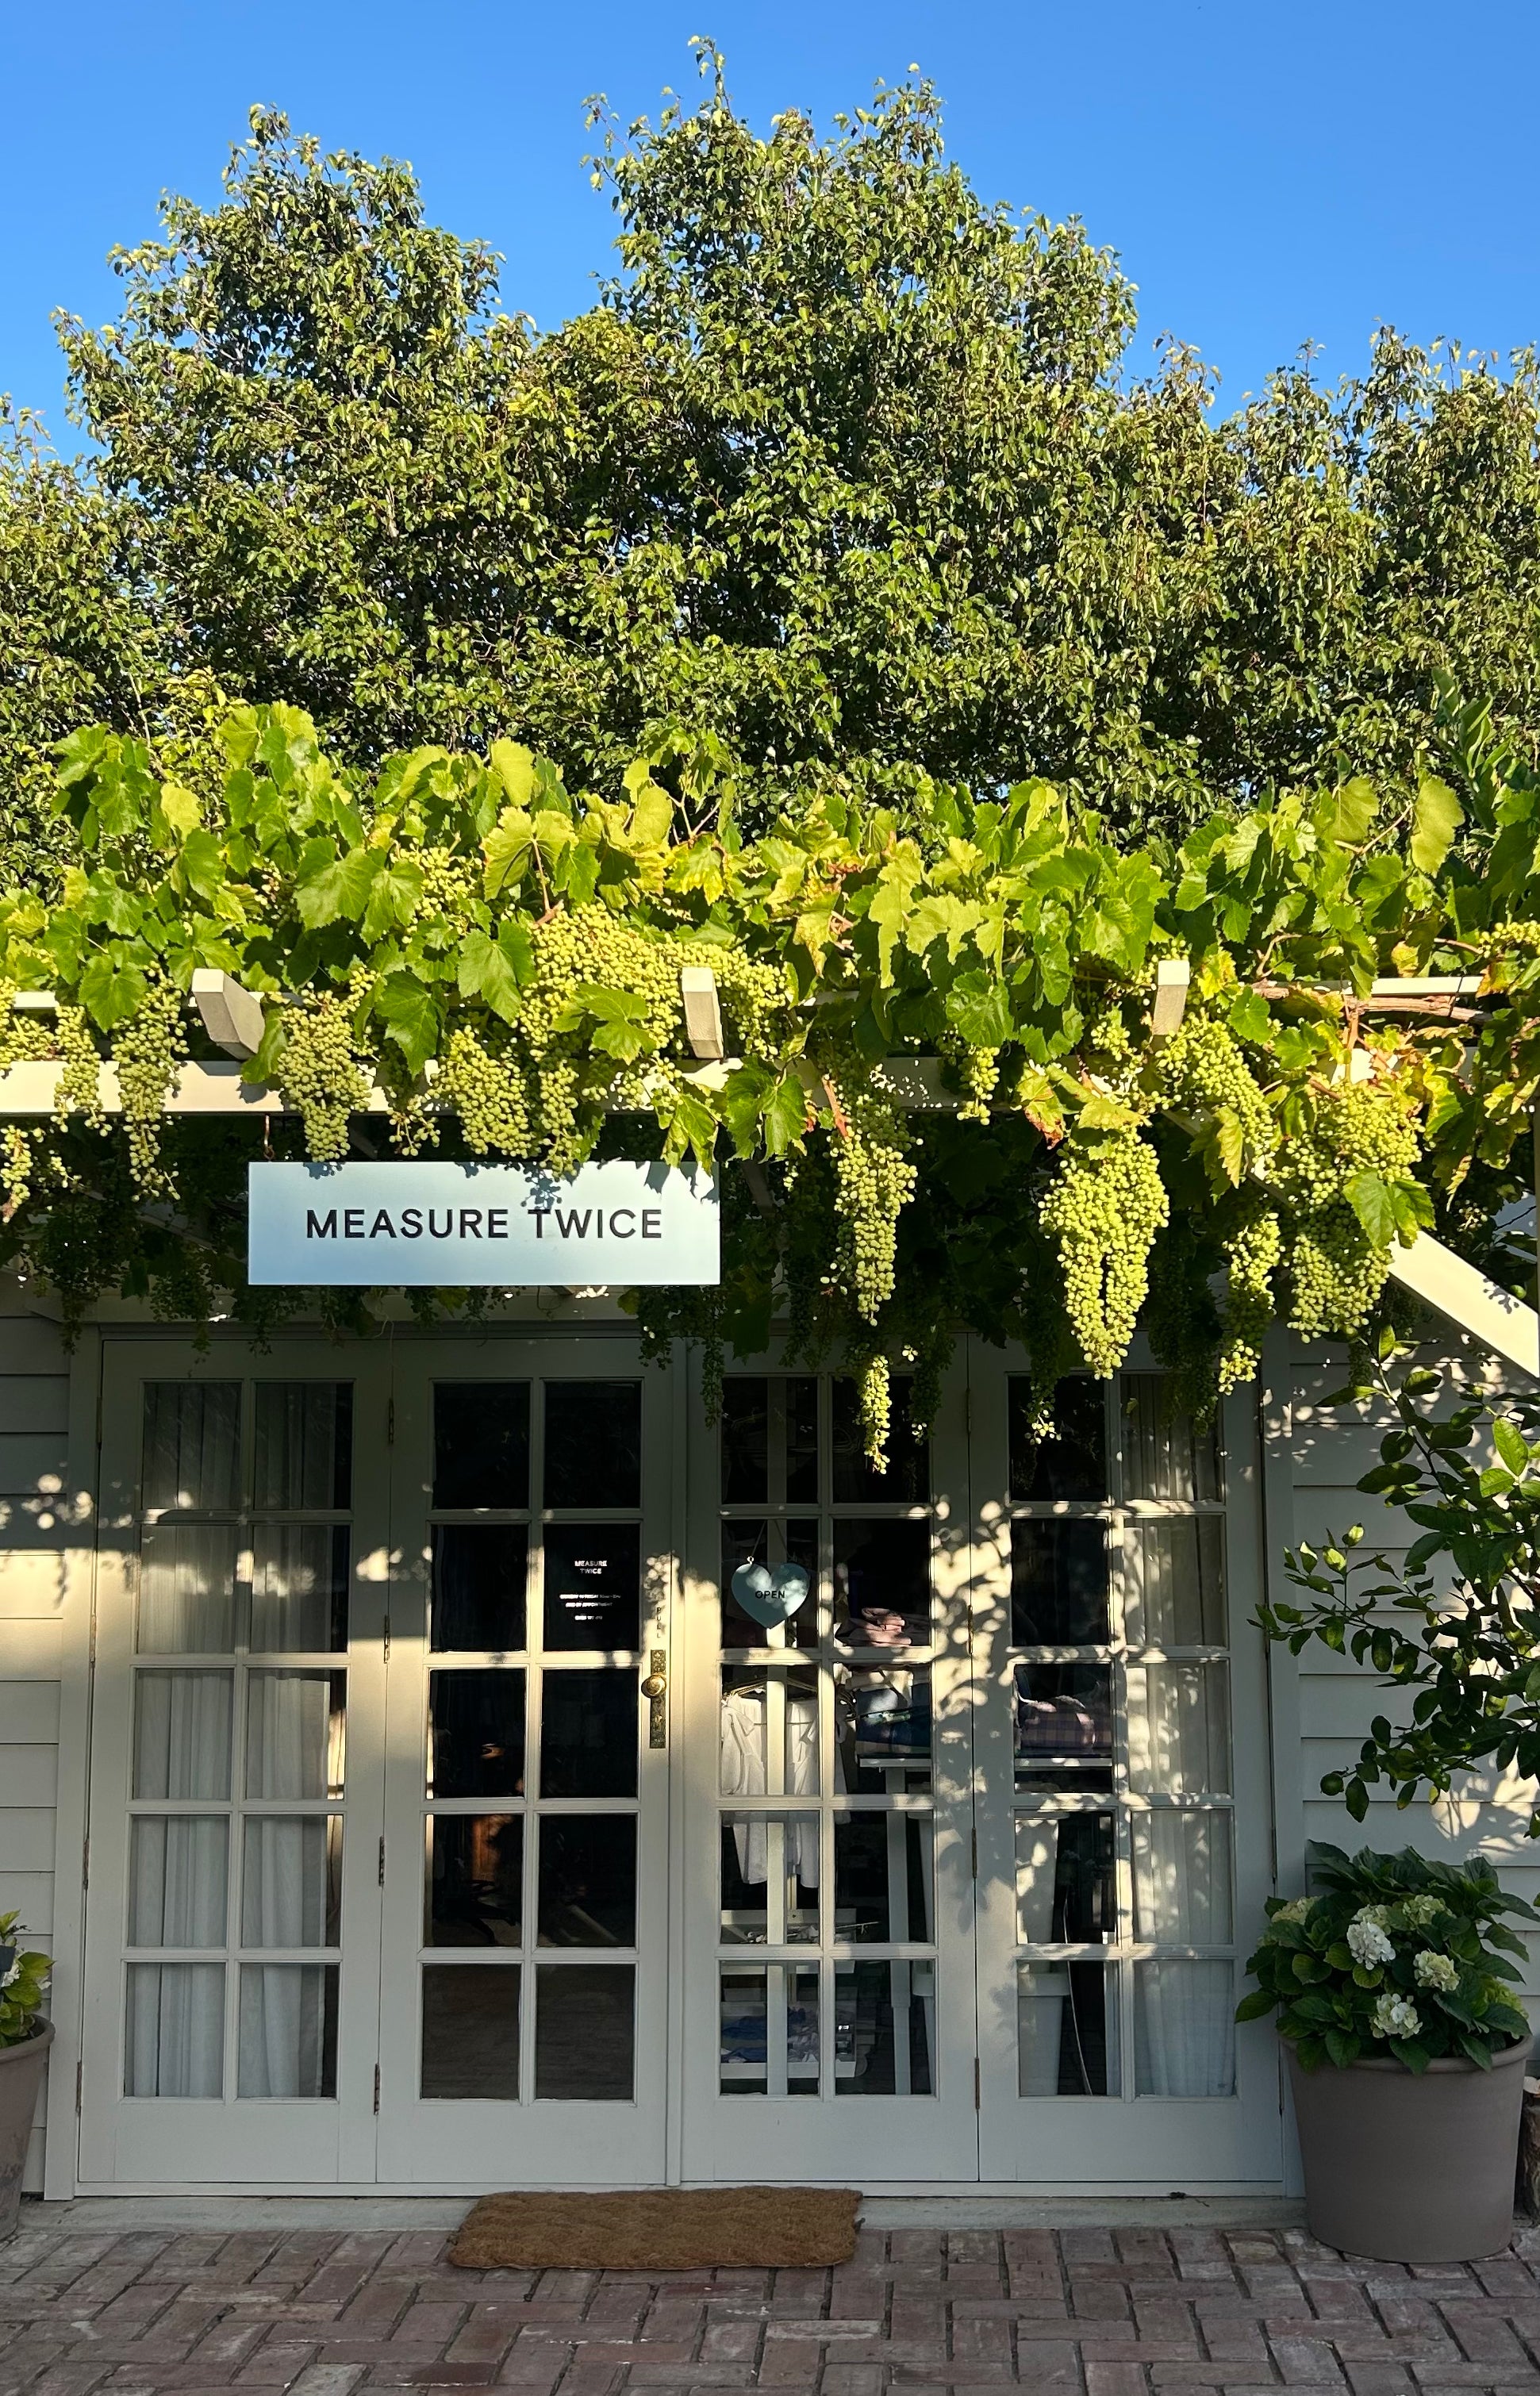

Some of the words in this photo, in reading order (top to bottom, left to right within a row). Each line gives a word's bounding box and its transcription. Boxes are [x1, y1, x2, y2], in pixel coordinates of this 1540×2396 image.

[306, 1208, 509, 1238] MEASURE
[528, 1208, 662, 1238] TWICE
[755, 1590, 785, 1599] OPEN
